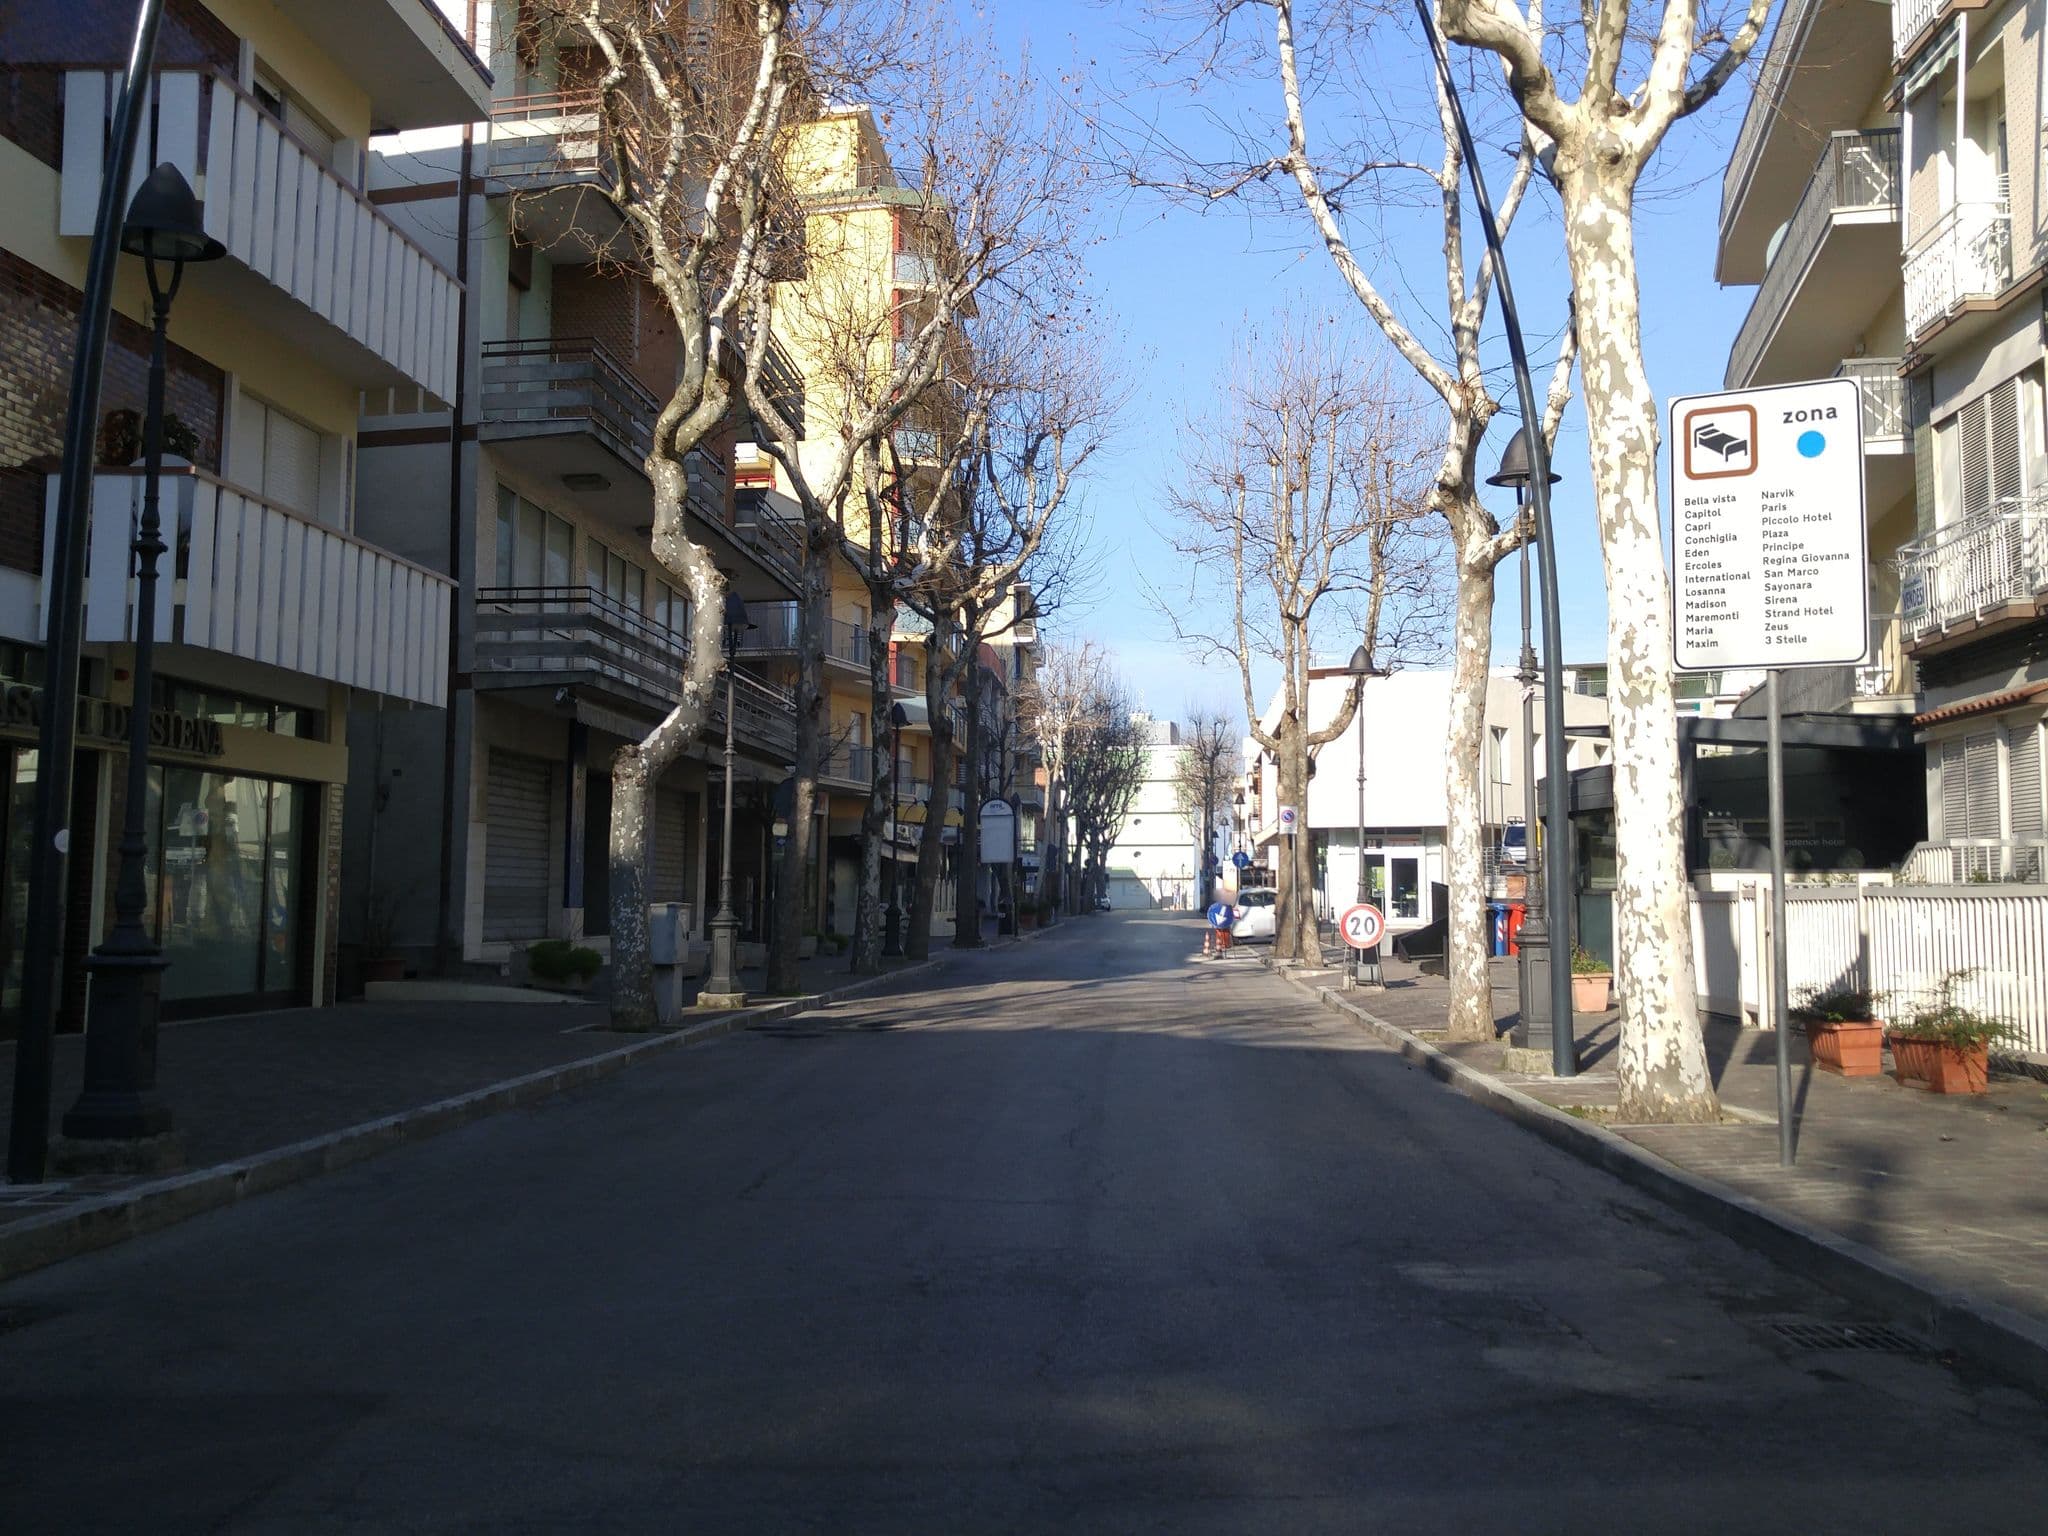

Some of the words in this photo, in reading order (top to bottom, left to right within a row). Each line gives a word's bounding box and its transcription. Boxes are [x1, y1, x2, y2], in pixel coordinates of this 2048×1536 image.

[1783, 405, 1838, 424] zona
[1762, 489, 1794, 499] Narvik
[1684, 497, 1709, 506] Bella
[1712, 495, 1736, 503] vista
[1762, 503, 1787, 512] Paris
[1685, 509, 1721, 519] Capitol
[1762, 516, 1799, 525] Piccolo
[1803, 513, 1832, 522] Hotel
[1685, 522, 1711, 532] Capri
[1685, 533, 1737, 544] Conchiglia
[1762, 530, 1789, 538] Plaza
[1763, 542, 1804, 552] Principe
[1685, 549, 1709, 557] Eden
[1763, 555, 1797, 566] Regina
[1802, 553, 1850, 562] Giovanna
[1685, 561, 1722, 570] Ercoles
[1685, 572, 1751, 583] International
[1764, 570, 1783, 578] San
[1685, 587, 1726, 596] Losanna
[1764, 582, 1812, 592] Sayonara
[1686, 600, 1726, 609] Madison
[1765, 596, 1797, 604] Sirena
[1686, 611, 1739, 622] Maremonti
[1765, 608, 1800, 618] Strand
[1804, 606, 1833, 616] Hotel
[1686, 626, 1713, 635] Maria
[1765, 623, 1789, 631] Zeus
[1686, 639, 1718, 648] Maxim
[1765, 636, 1772, 644] 3
[1776, 635, 1807, 644] Stelle
[150, 709, 224, 756] SIENA
[1350, 916, 1376, 936] 20
